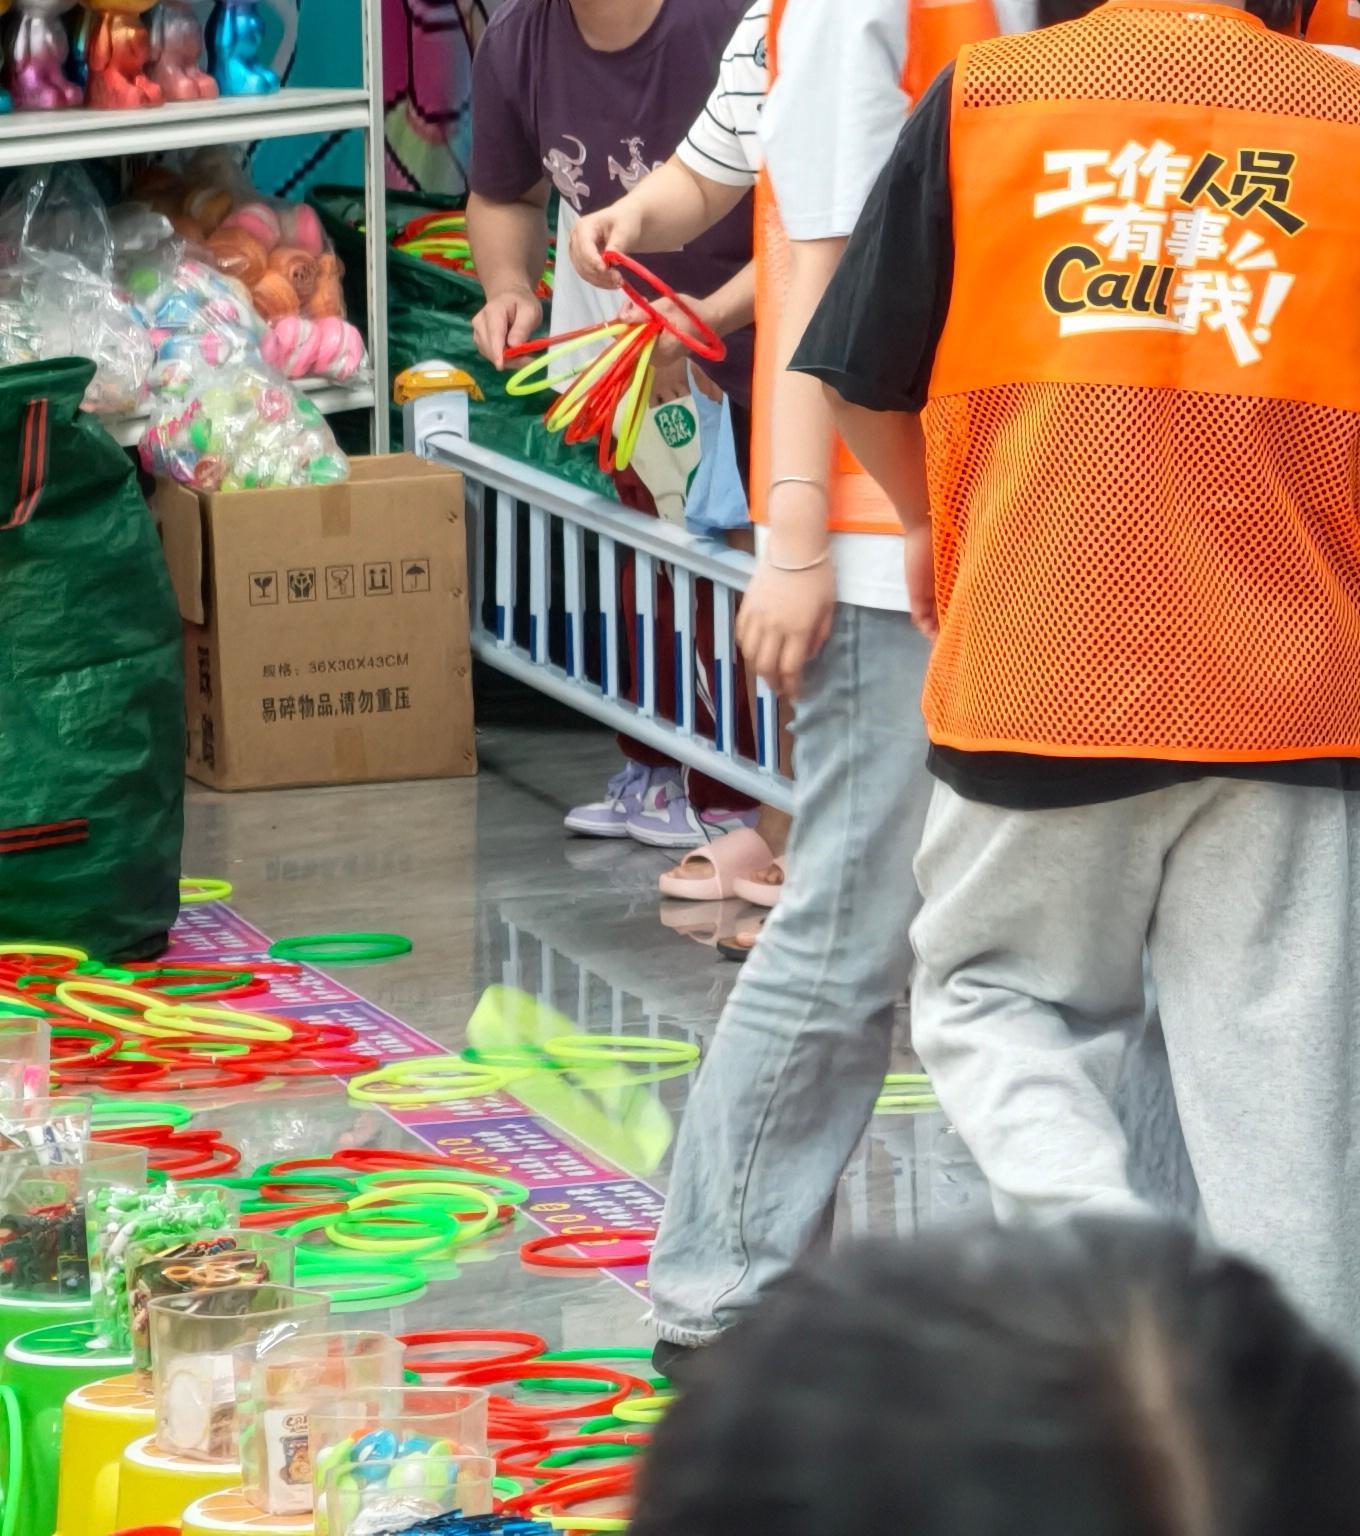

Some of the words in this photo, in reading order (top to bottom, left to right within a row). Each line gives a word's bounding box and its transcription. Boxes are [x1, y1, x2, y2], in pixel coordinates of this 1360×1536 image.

[1033, 137, 1307, 236] 工作人员
[1082, 203, 1231, 271] 有事
